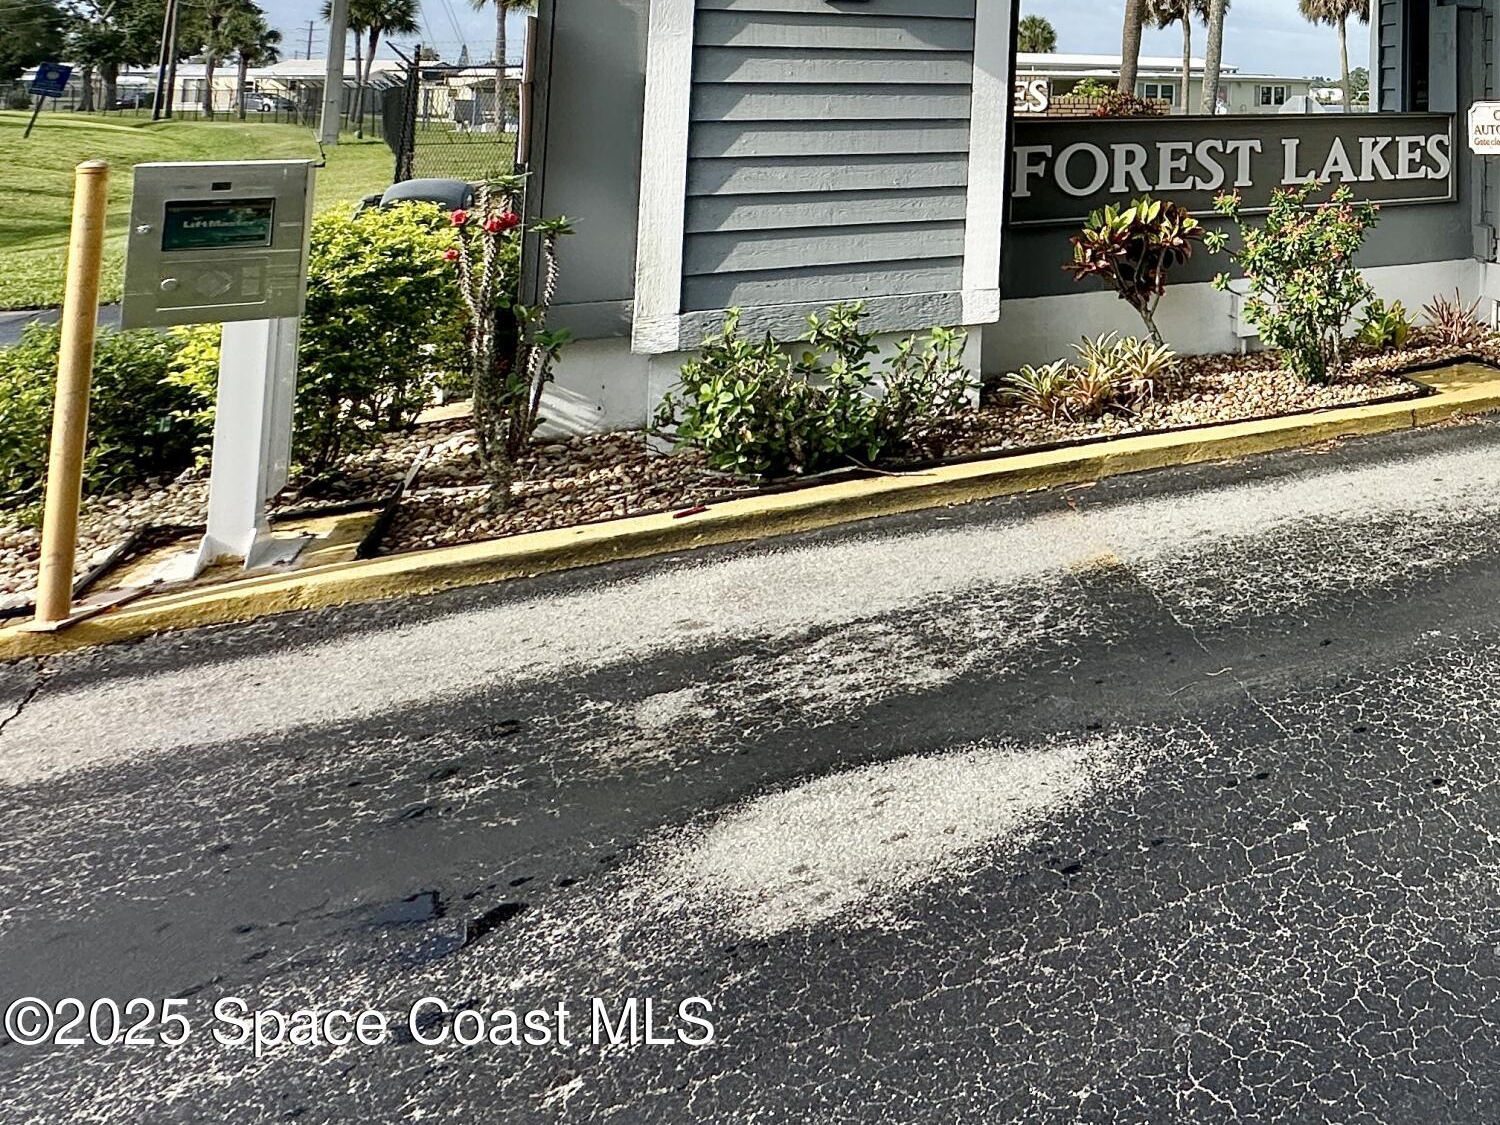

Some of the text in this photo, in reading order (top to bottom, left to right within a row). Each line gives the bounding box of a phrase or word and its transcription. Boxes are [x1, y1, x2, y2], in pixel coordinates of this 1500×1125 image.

[1474, 137, 1490, 146] Gate
[1011, 134, 1450, 198] FOREST LAKES
